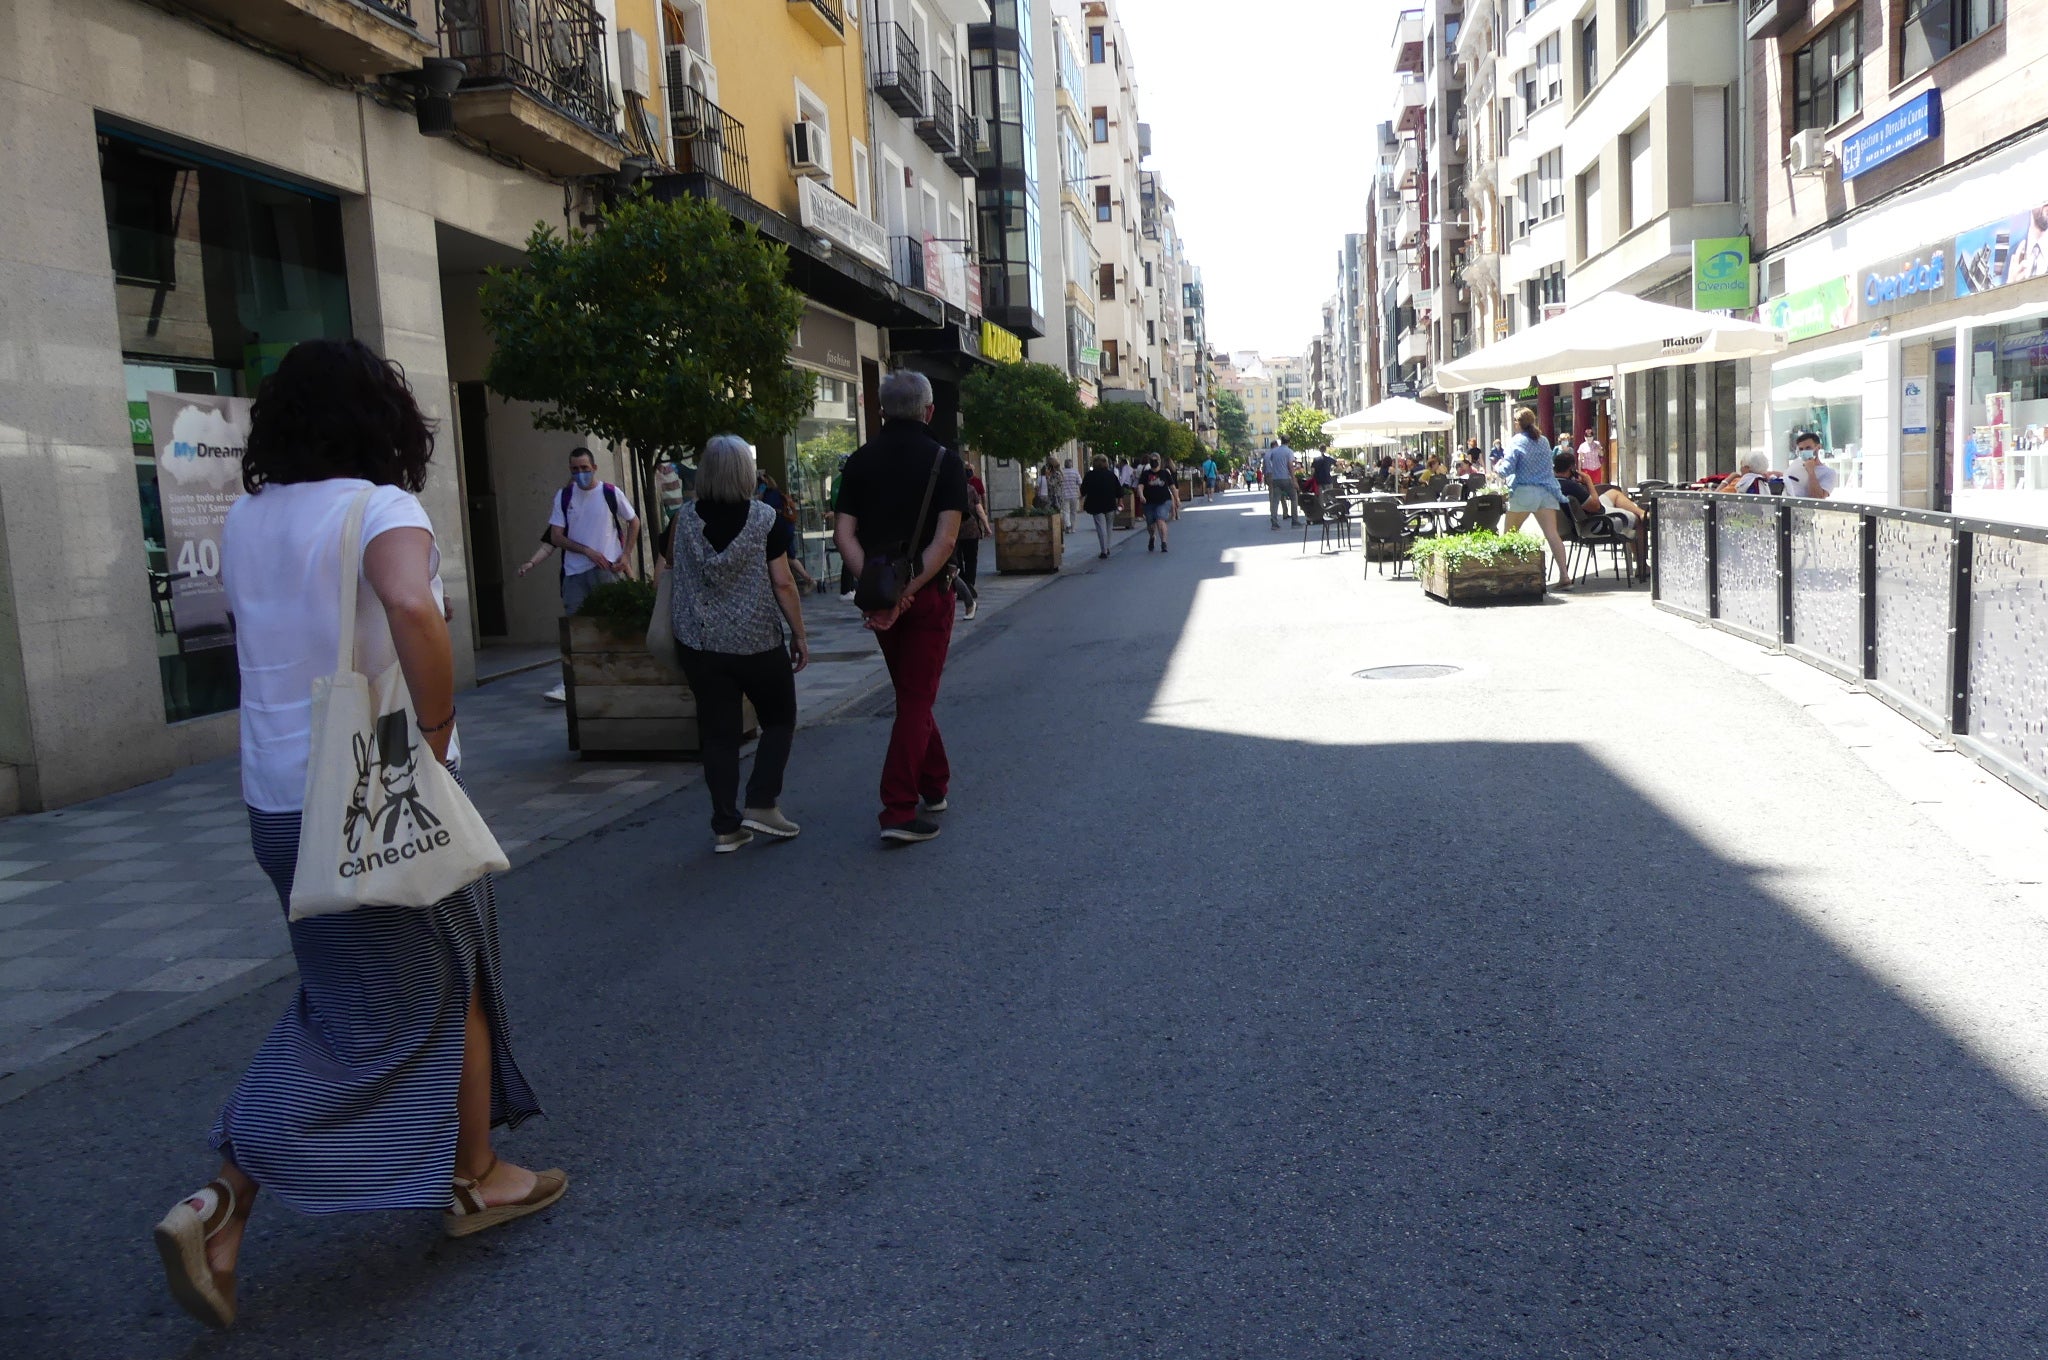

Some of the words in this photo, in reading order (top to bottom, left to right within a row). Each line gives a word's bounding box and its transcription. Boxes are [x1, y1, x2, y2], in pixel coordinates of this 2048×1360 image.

[1662, 336, 1703, 348] Mahou
[827, 350, 850, 368] fashion
[196, 493, 214, 503] todo
[216, 493, 224, 502] el
[187, 505, 196, 513] tu
[197, 504, 208, 513] TV
[339, 828, 451, 879] canecue
